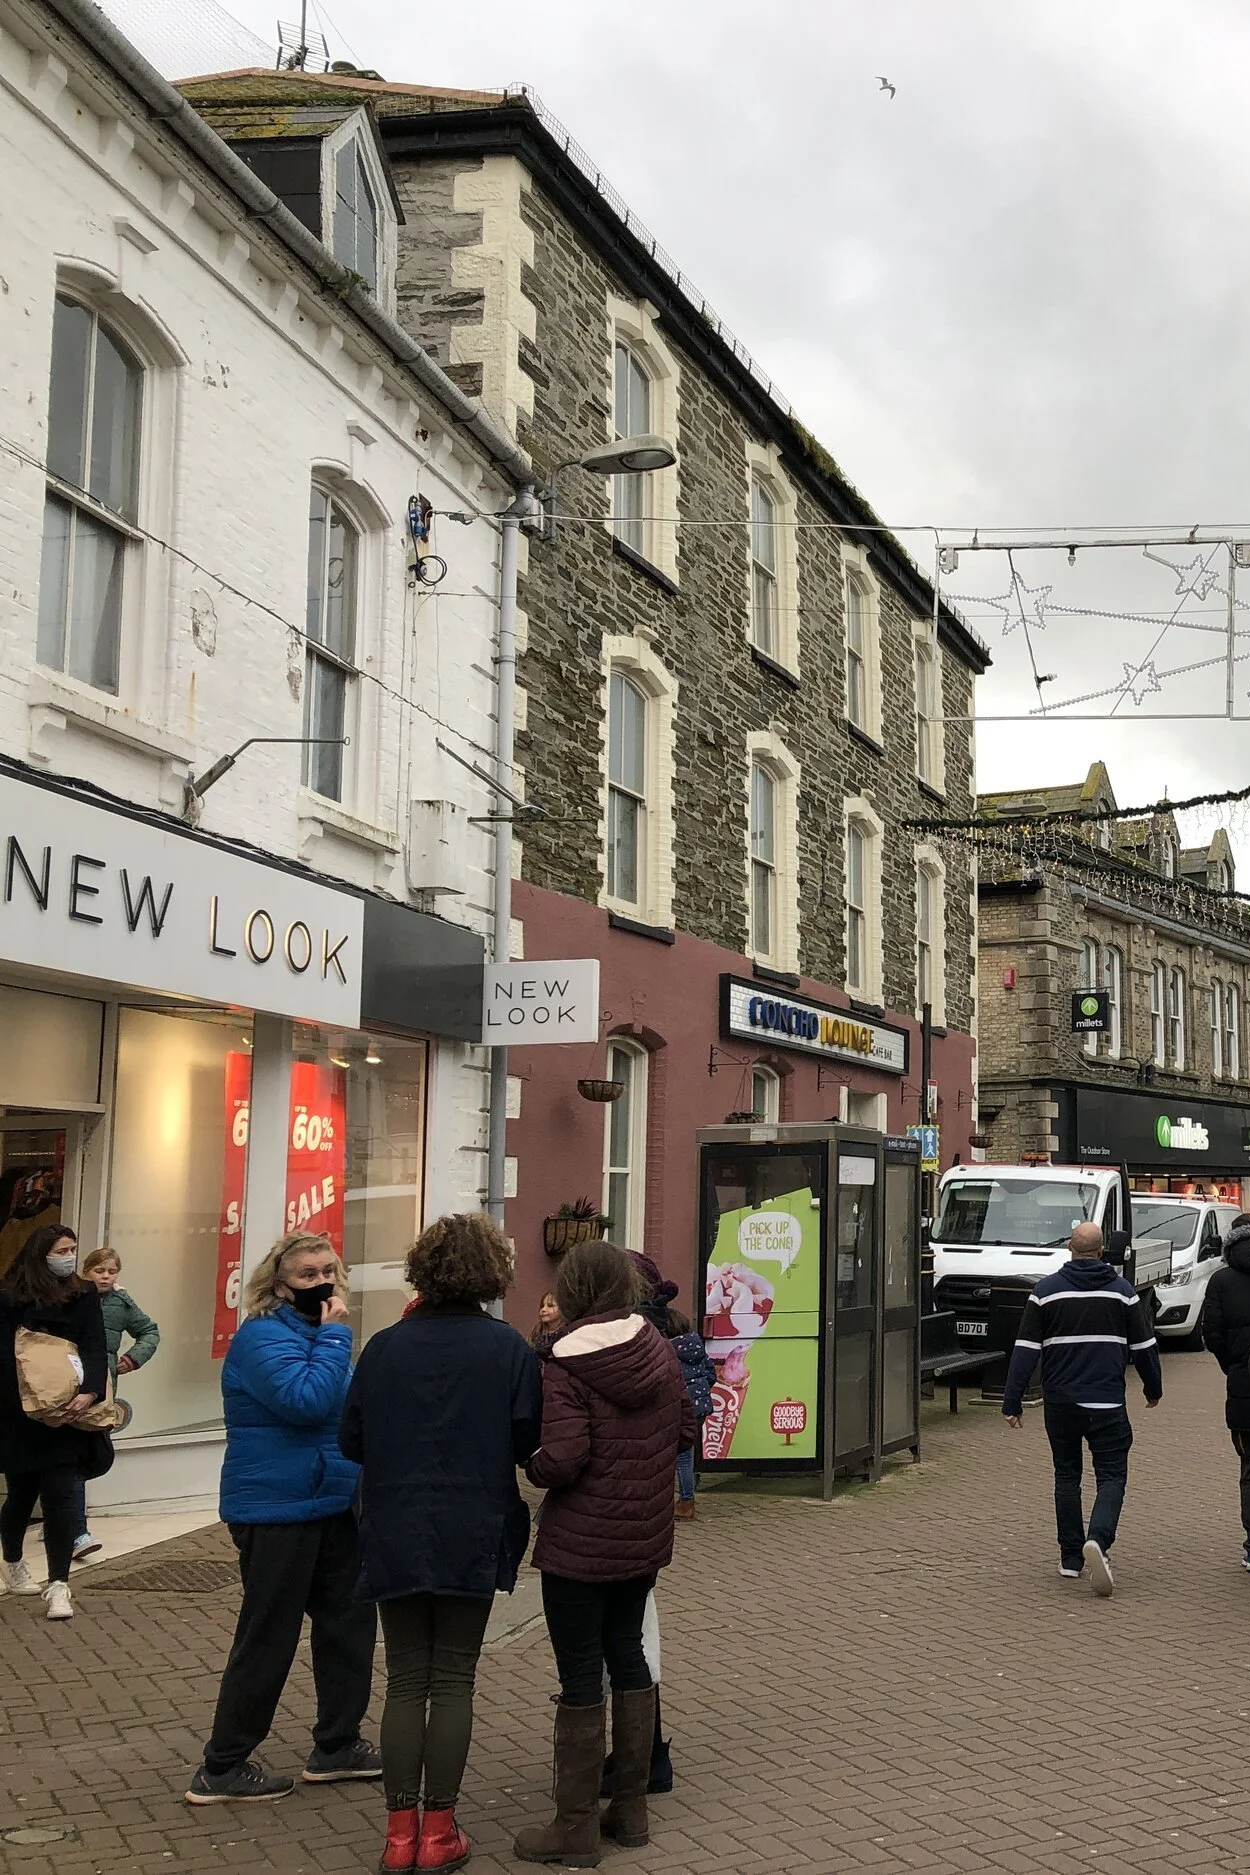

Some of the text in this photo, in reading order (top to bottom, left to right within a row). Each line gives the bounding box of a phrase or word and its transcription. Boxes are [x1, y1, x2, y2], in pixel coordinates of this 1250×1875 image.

[4, 835, 349, 985] NEW LOOK
[495, 979, 570, 999] NEW
[487, 1005, 576, 1026] LOOK
[749, 996, 819, 1040] CONCHO
[820, 1016, 875, 1055] LOUNGE
[1076, 1018, 1103, 1028] millets
[1170, 1117, 1209, 1150] millets
[319, 1141, 333, 1152] OFF
[287, 1175, 336, 1233] SALE
[749, 1221, 789, 1235] PICK UP
[745, 1236, 794, 1251] THE CONE!
[958, 1323, 982, 1334] BD70
